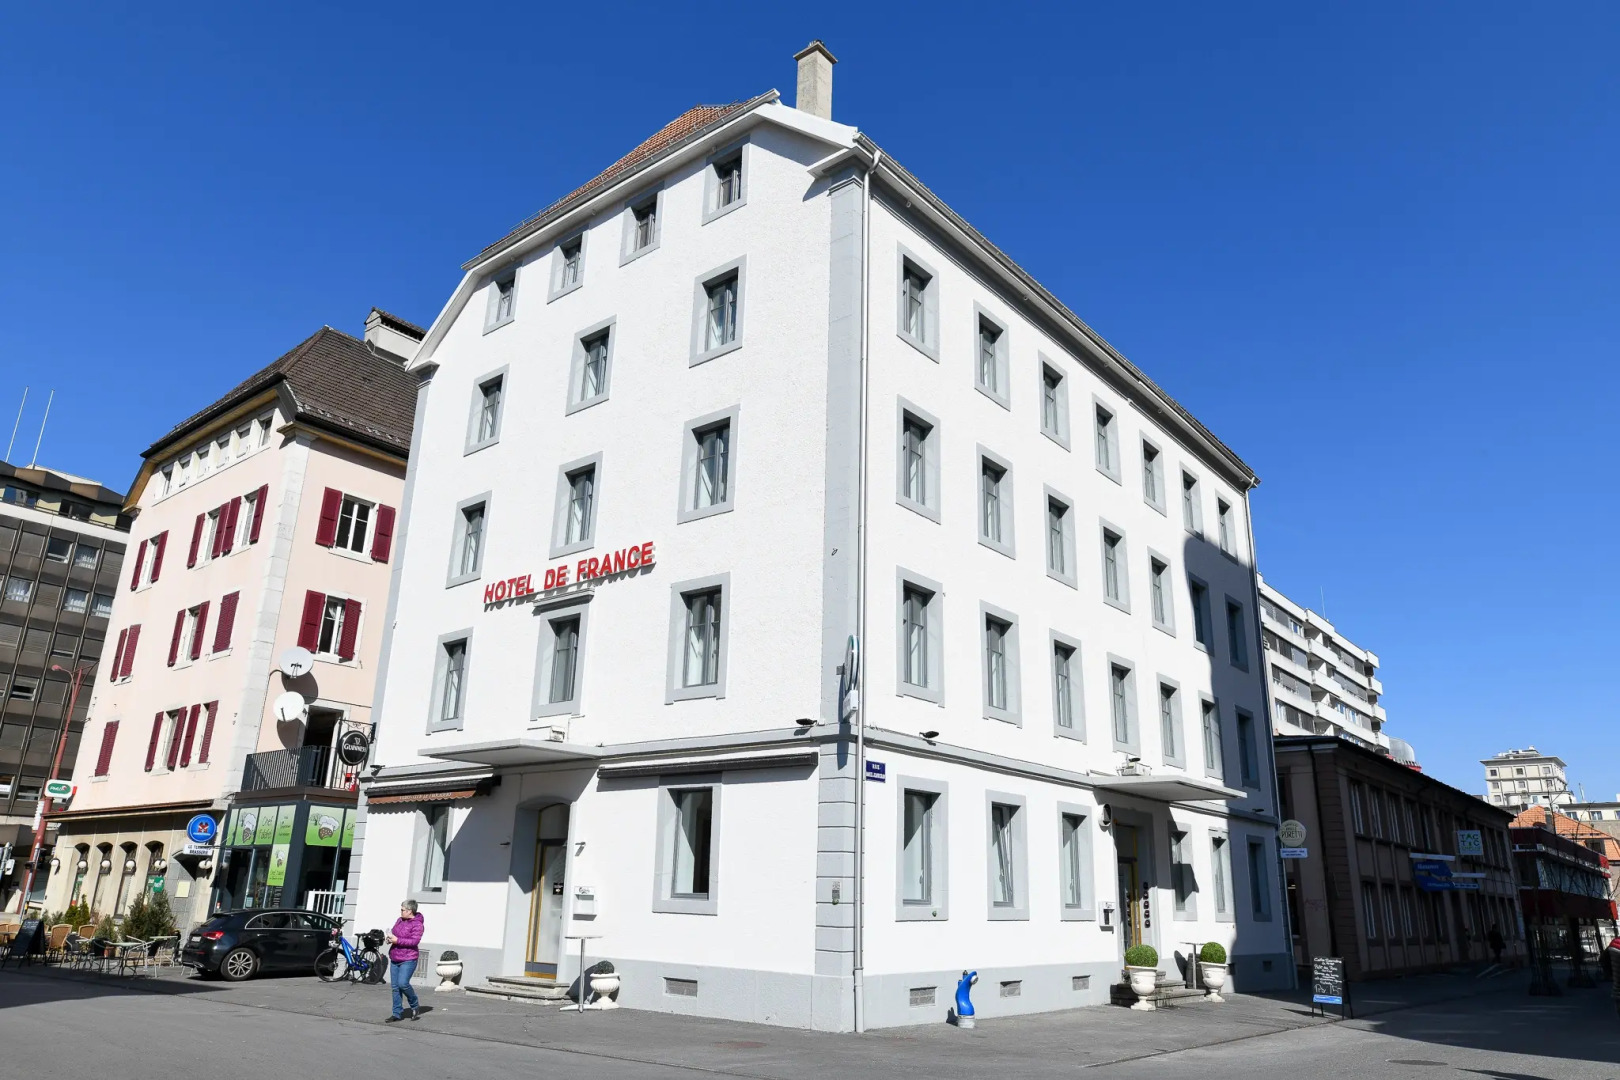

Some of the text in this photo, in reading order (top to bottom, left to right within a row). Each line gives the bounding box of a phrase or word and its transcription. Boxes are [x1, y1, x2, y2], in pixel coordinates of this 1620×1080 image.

[484, 541, 654, 604] HOTEL DE FRANCE
